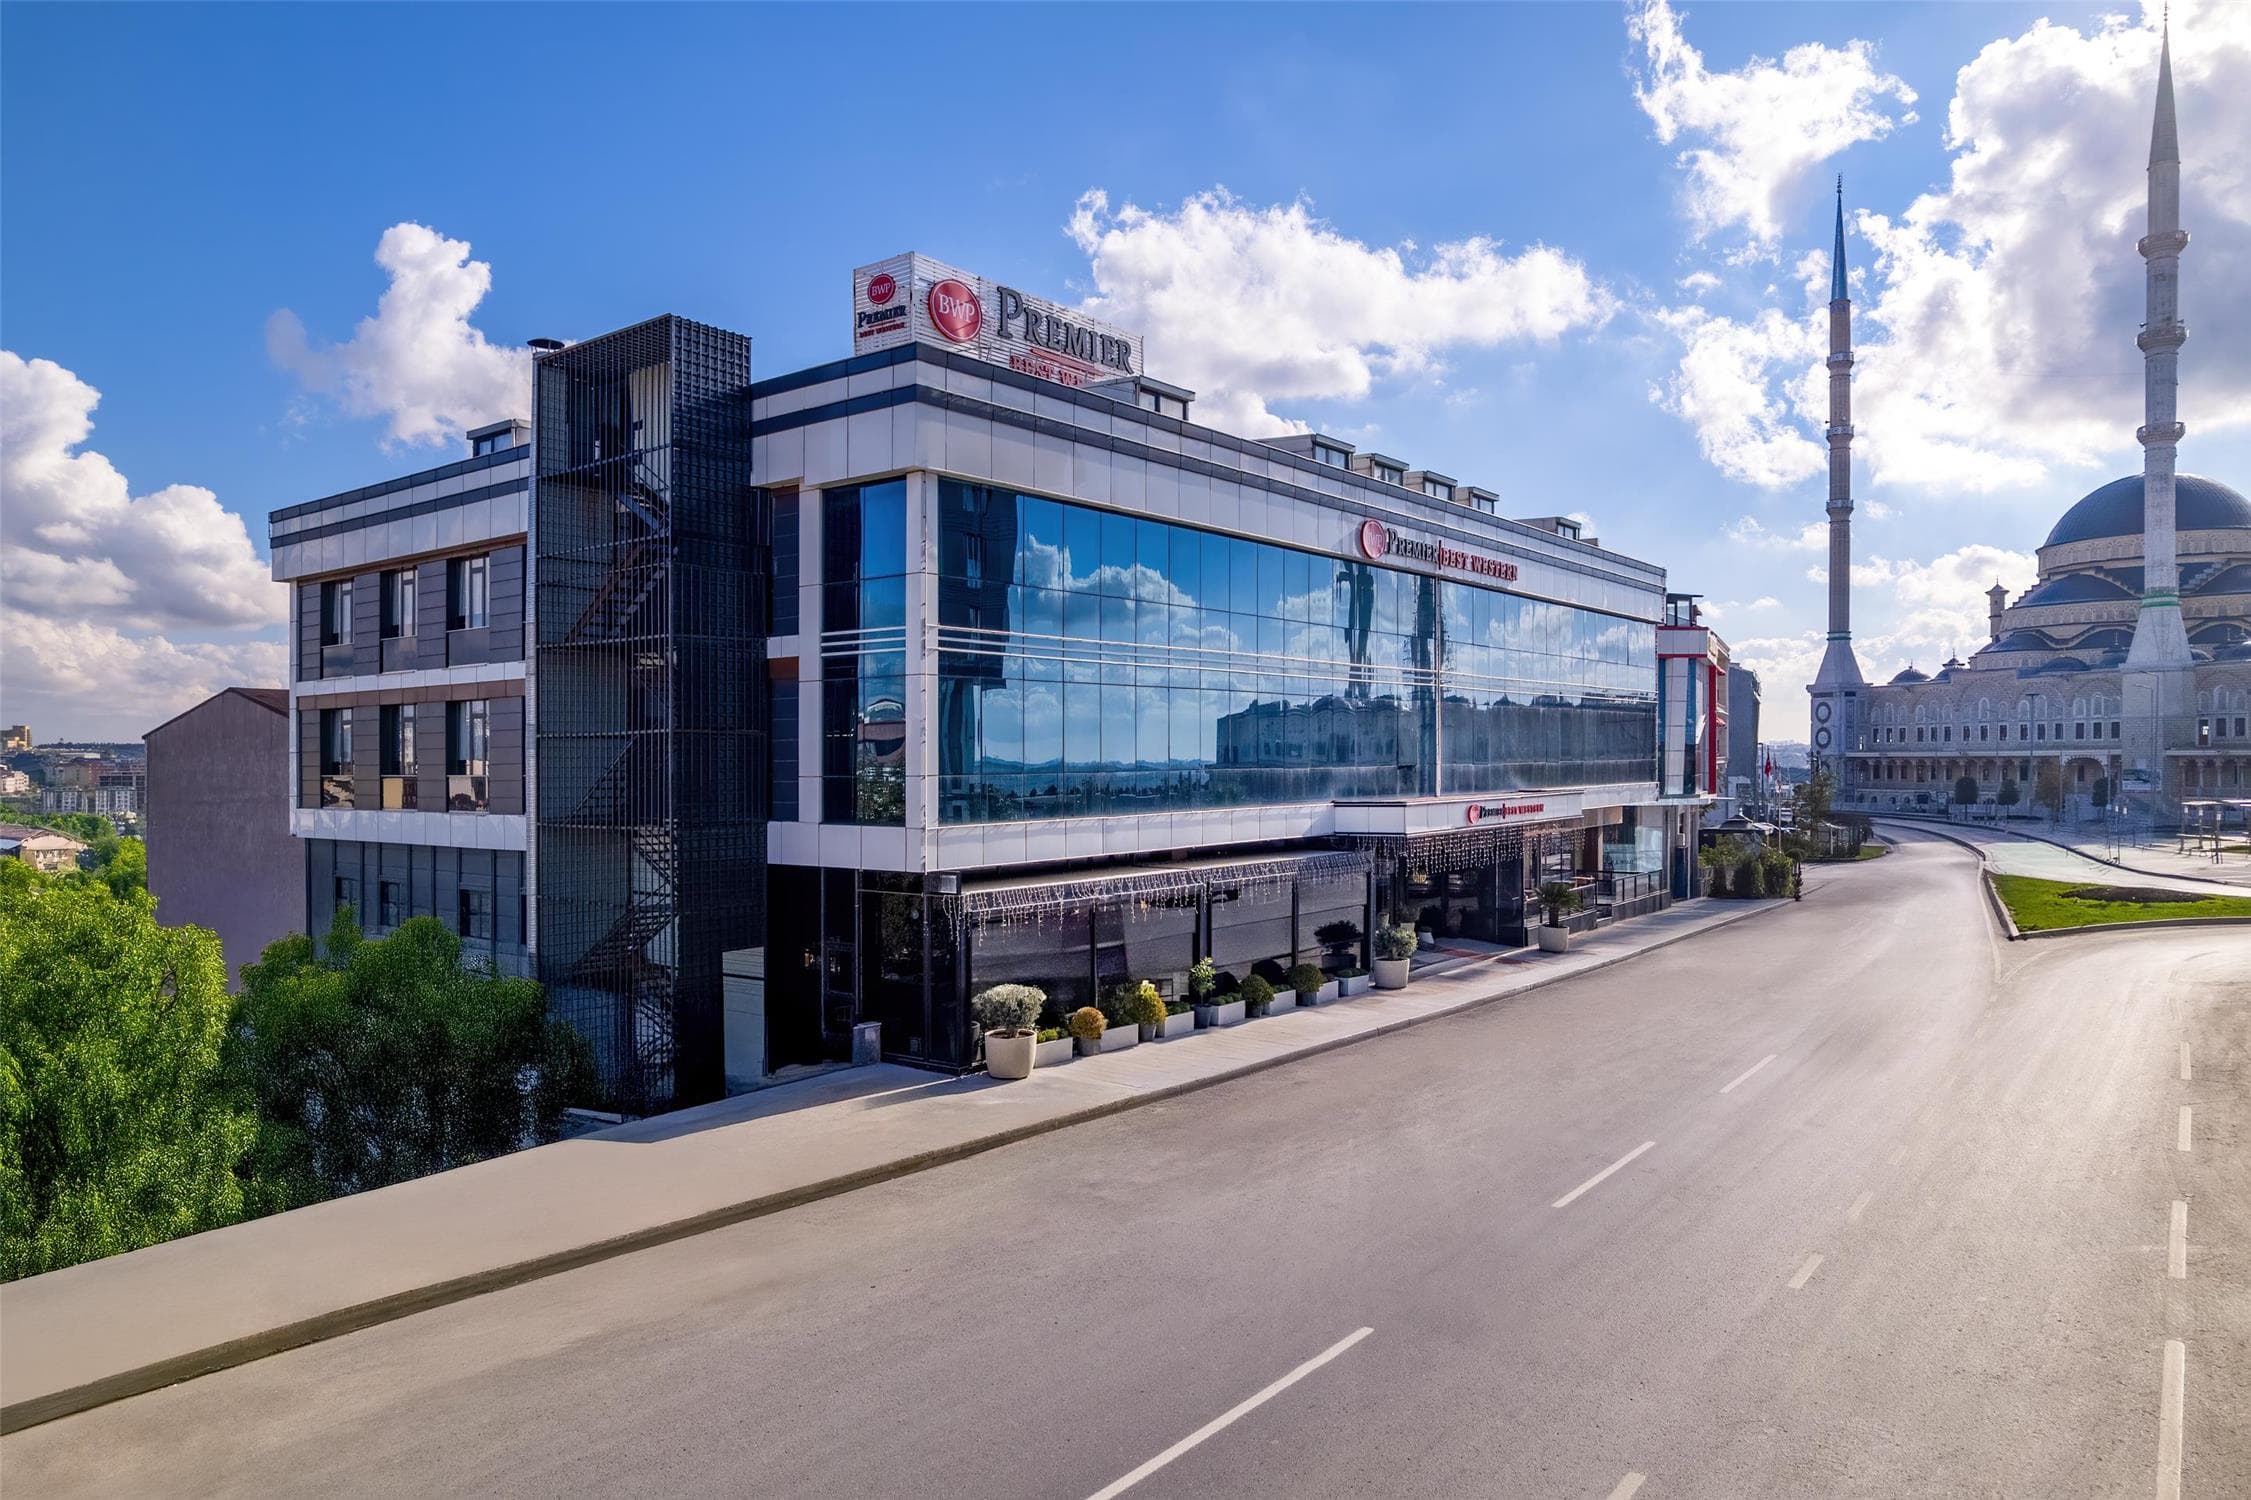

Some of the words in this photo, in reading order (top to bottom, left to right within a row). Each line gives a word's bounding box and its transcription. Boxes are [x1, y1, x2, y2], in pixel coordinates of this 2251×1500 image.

[871, 283, 891, 296] BWP
[938, 294, 975, 322] BWP
[997, 286, 1134, 375] PREMIER
[1387, 528, 1438, 563] PREMIER
[1441, 547, 1468, 569] BEST
[1471, 555, 1518, 581] WESTERN
